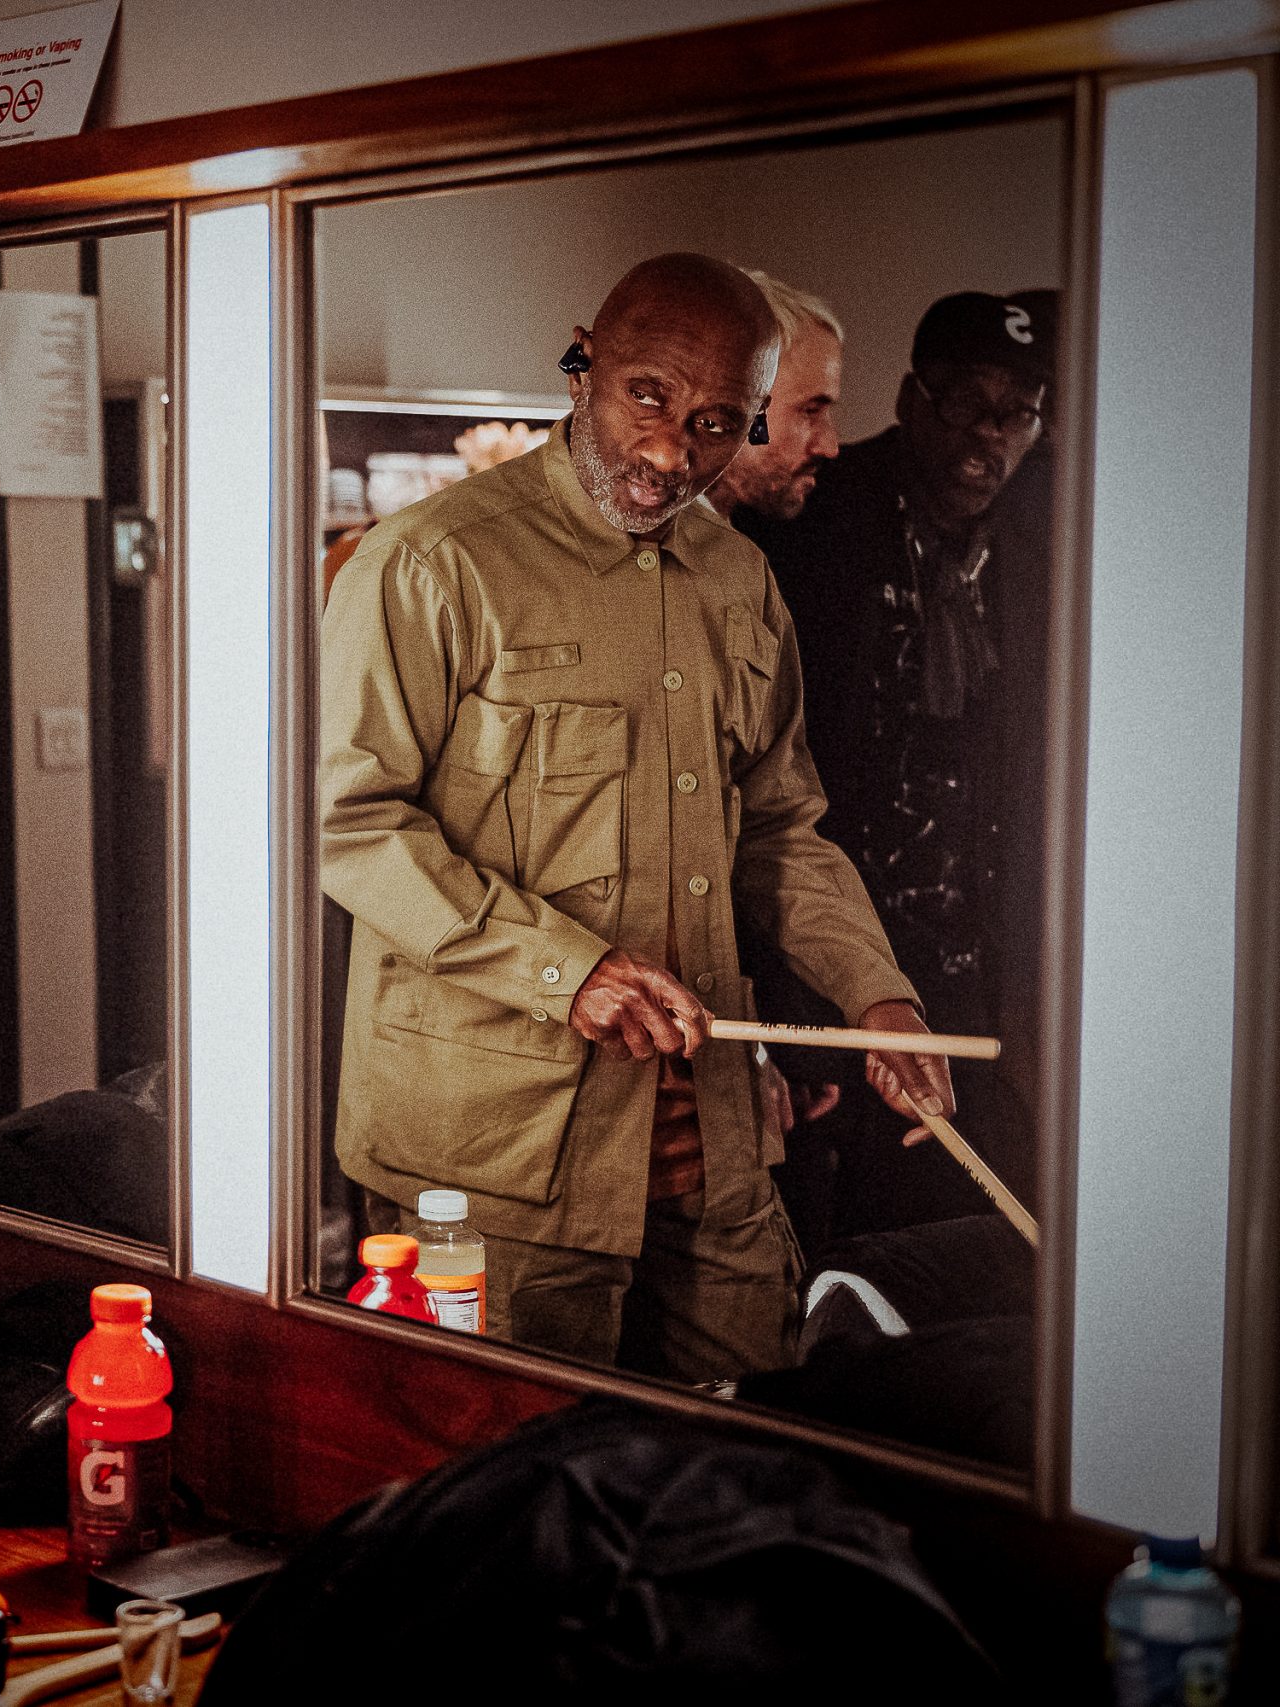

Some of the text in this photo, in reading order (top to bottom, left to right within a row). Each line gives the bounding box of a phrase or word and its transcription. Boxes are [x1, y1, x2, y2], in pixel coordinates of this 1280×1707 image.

[35, 45, 47, 56] or
[49, 38, 83, 54] Vaping
[80, 1450, 126, 1506] G
